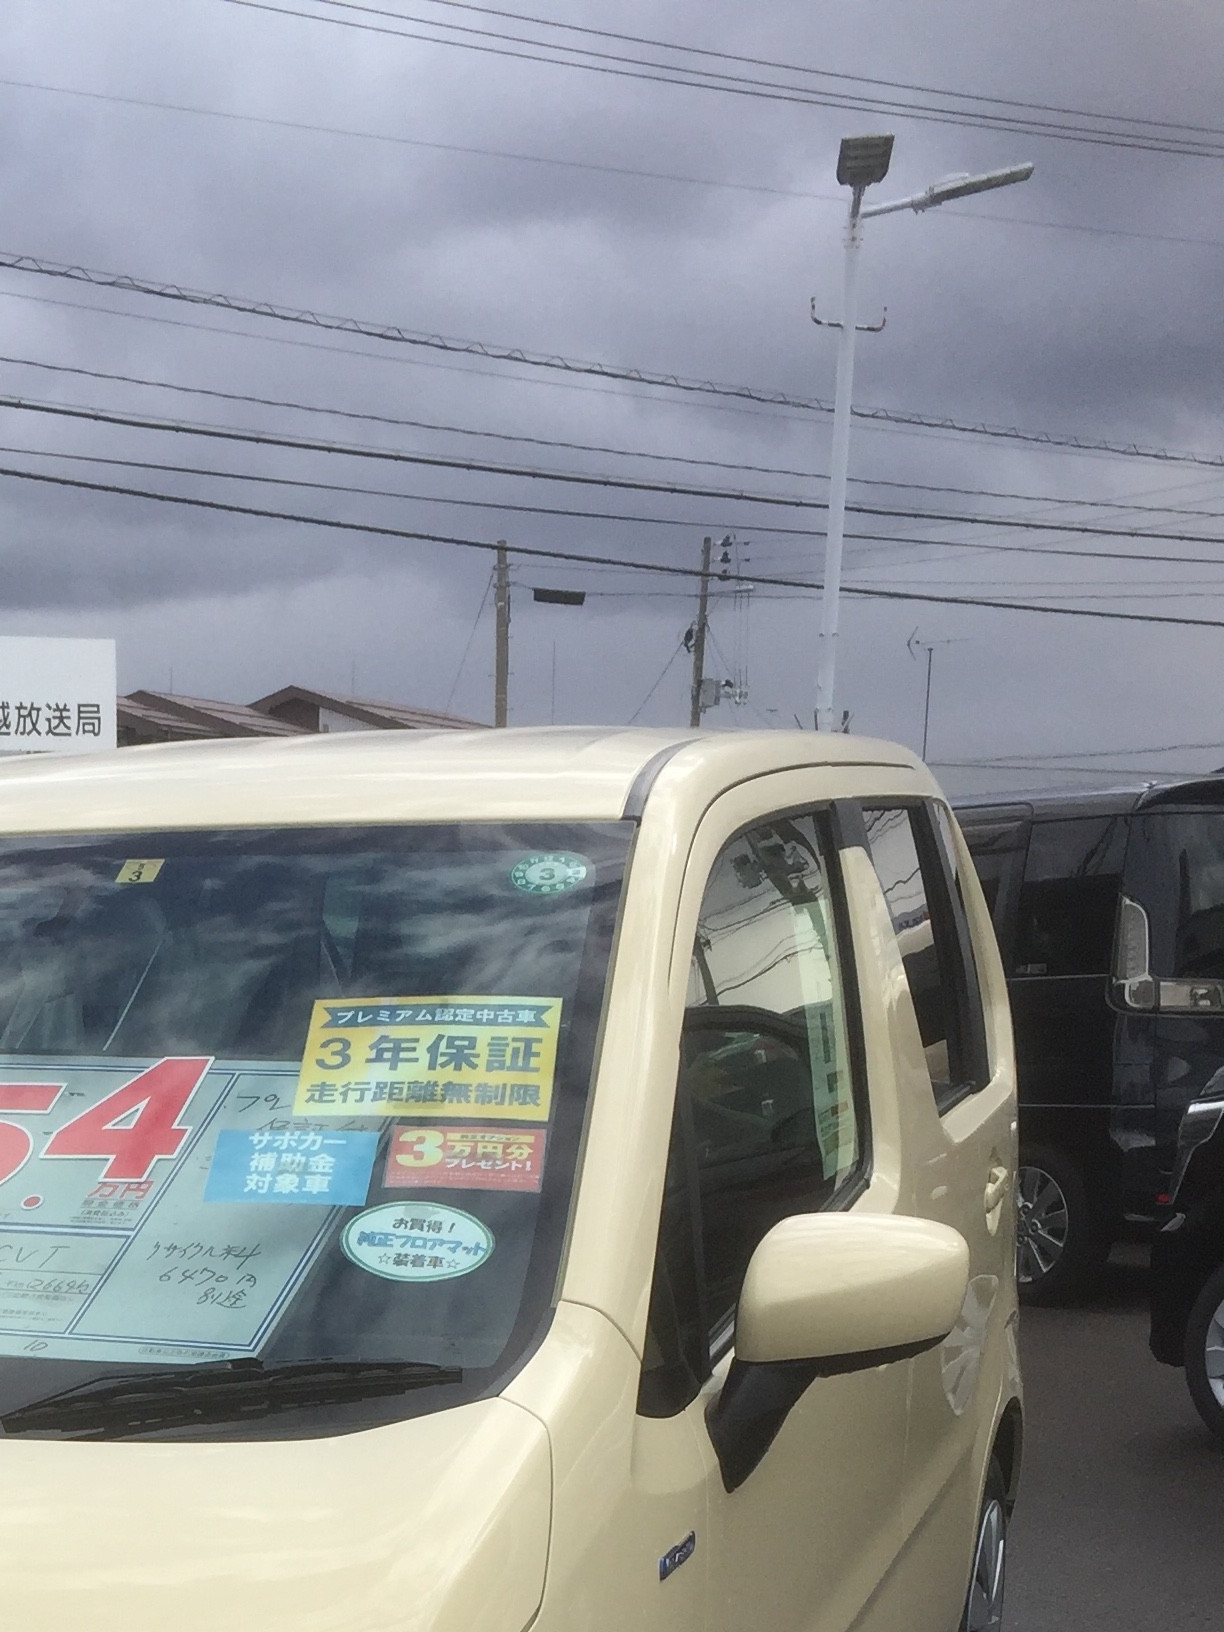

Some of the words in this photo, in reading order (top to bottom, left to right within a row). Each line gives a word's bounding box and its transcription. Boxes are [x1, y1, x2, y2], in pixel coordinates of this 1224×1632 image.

[128, 870, 143, 882] 3
[538, 867, 556, 881] 3
[336, 1007, 537, 1025] プレミアム認定中古車
[315, 1033, 544, 1073] 3年保証
[305, 1080, 542, 1107] 走行距離無制限
[249, 1131, 347, 1151] サポカー
[395, 1129, 445, 1168] 3
[447, 1142, 534, 1160] 万円分
[249, 1152, 336, 1173] 補助金
[87, 1181, 155, 1200] 万円
[243, 1173, 333, 1195] 対象車
[356, 1230, 487, 1256] 純正フロアマット
